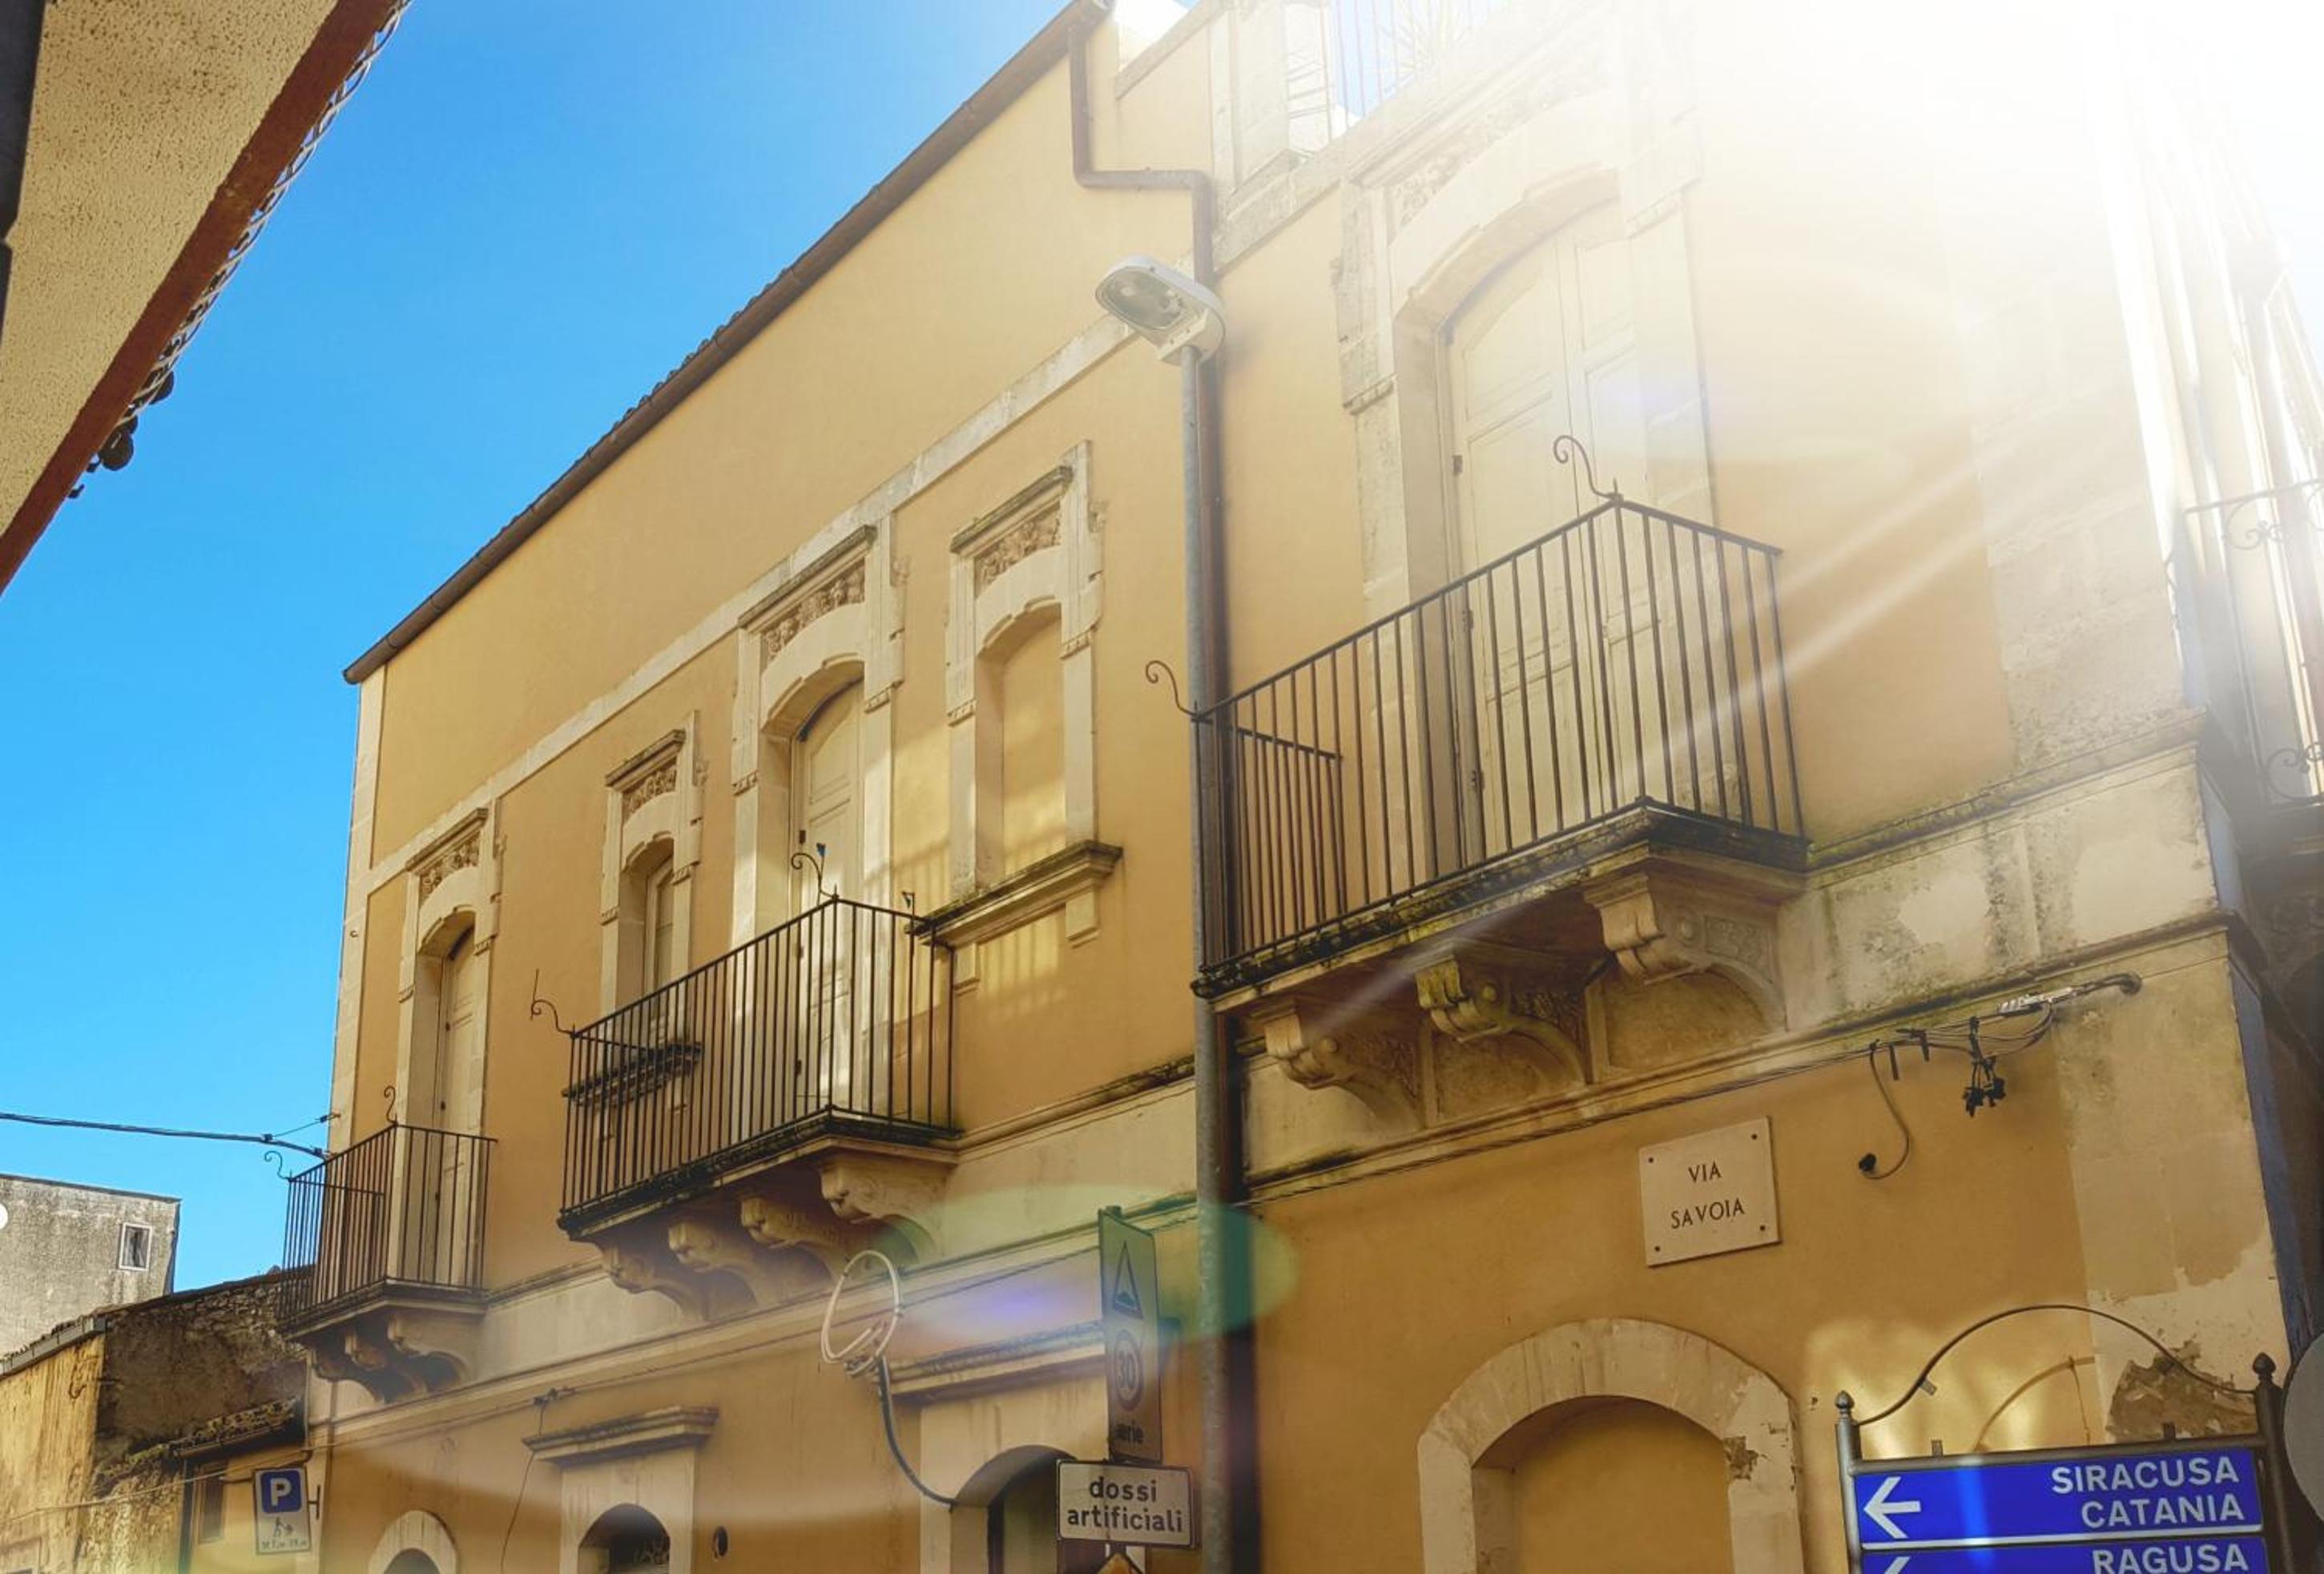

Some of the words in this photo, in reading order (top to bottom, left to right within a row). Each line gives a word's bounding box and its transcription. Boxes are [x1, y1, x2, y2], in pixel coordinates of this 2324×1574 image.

[1688, 1160, 1722, 1183] VIA
[1670, 1197, 1745, 1230] SAVOIA
[1118, 1351, 1136, 1391] 30
[1090, 1476, 1157, 1503] dossi
[2051, 1455, 2240, 1494] SIRACUSA
[270, 1477, 292, 1507] P
[1067, 1504, 1183, 1533] artificiali
[2080, 1492, 2245, 1529] CATANIA
[2092, 1543, 2249, 1574] RAGUSA
